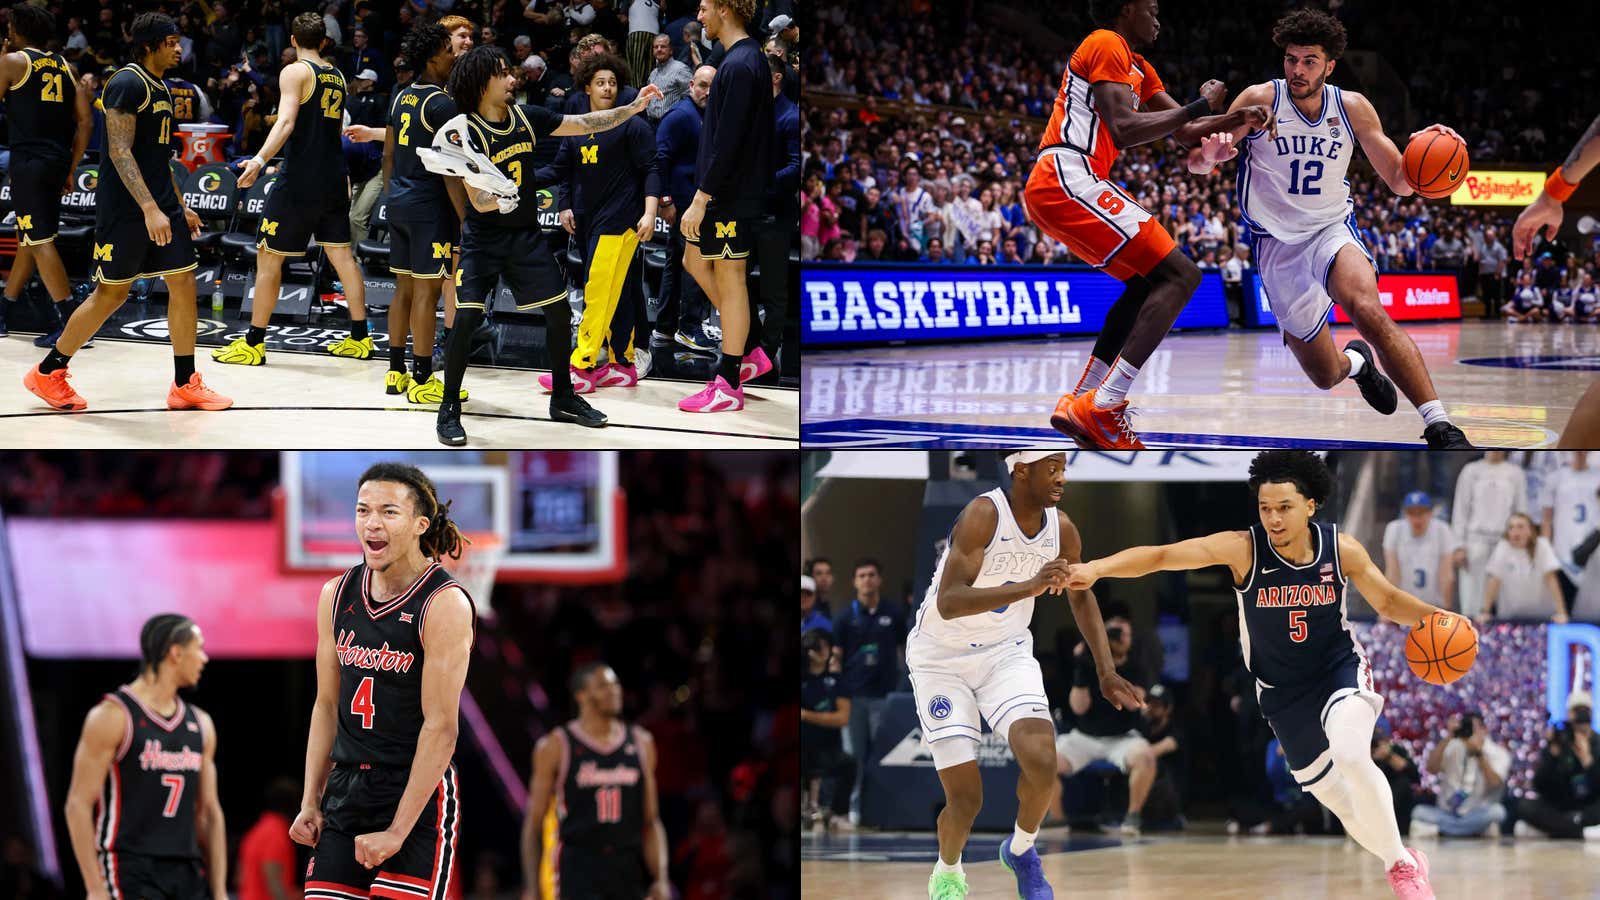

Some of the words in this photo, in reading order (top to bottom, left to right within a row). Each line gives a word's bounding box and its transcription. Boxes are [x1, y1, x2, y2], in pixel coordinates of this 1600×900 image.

[41, 72, 64, 103] 21
[174, 96, 193, 119] 21
[320, 87, 343, 119] 42
[400, 93, 420, 108] CASON
[158, 116, 171, 144] 11
[398, 112, 411, 146] 2
[193, 139, 206, 153] G
[490, 141, 533, 165] MICHIGAN
[580, 144, 599, 165] M
[1274, 135, 1343, 160] DUKE
[507, 160, 522, 188] 3
[1288, 159, 1324, 195] 12
[1466, 176, 1533, 200] Bojangles
[183, 192, 228, 210] GEMCO
[1097, 190, 1126, 216] S
[17, 214, 33, 231] M
[260, 217, 279, 236] M
[715, 220, 737, 239] M
[94, 242, 113, 262] M
[432, 242, 452, 259] M
[805, 281, 1081, 331] BASKETBALL
[1574, 504, 1587, 523] 3
[1414, 568, 1427, 588] 3
[1256, 584, 1336, 608] ARIZONA
[1289, 610, 1308, 643] 5
[336, 628, 414, 673] Houston
[351, 676, 376, 730] 4
[161, 774, 185, 818] 7
[596, 787, 622, 824] 11
